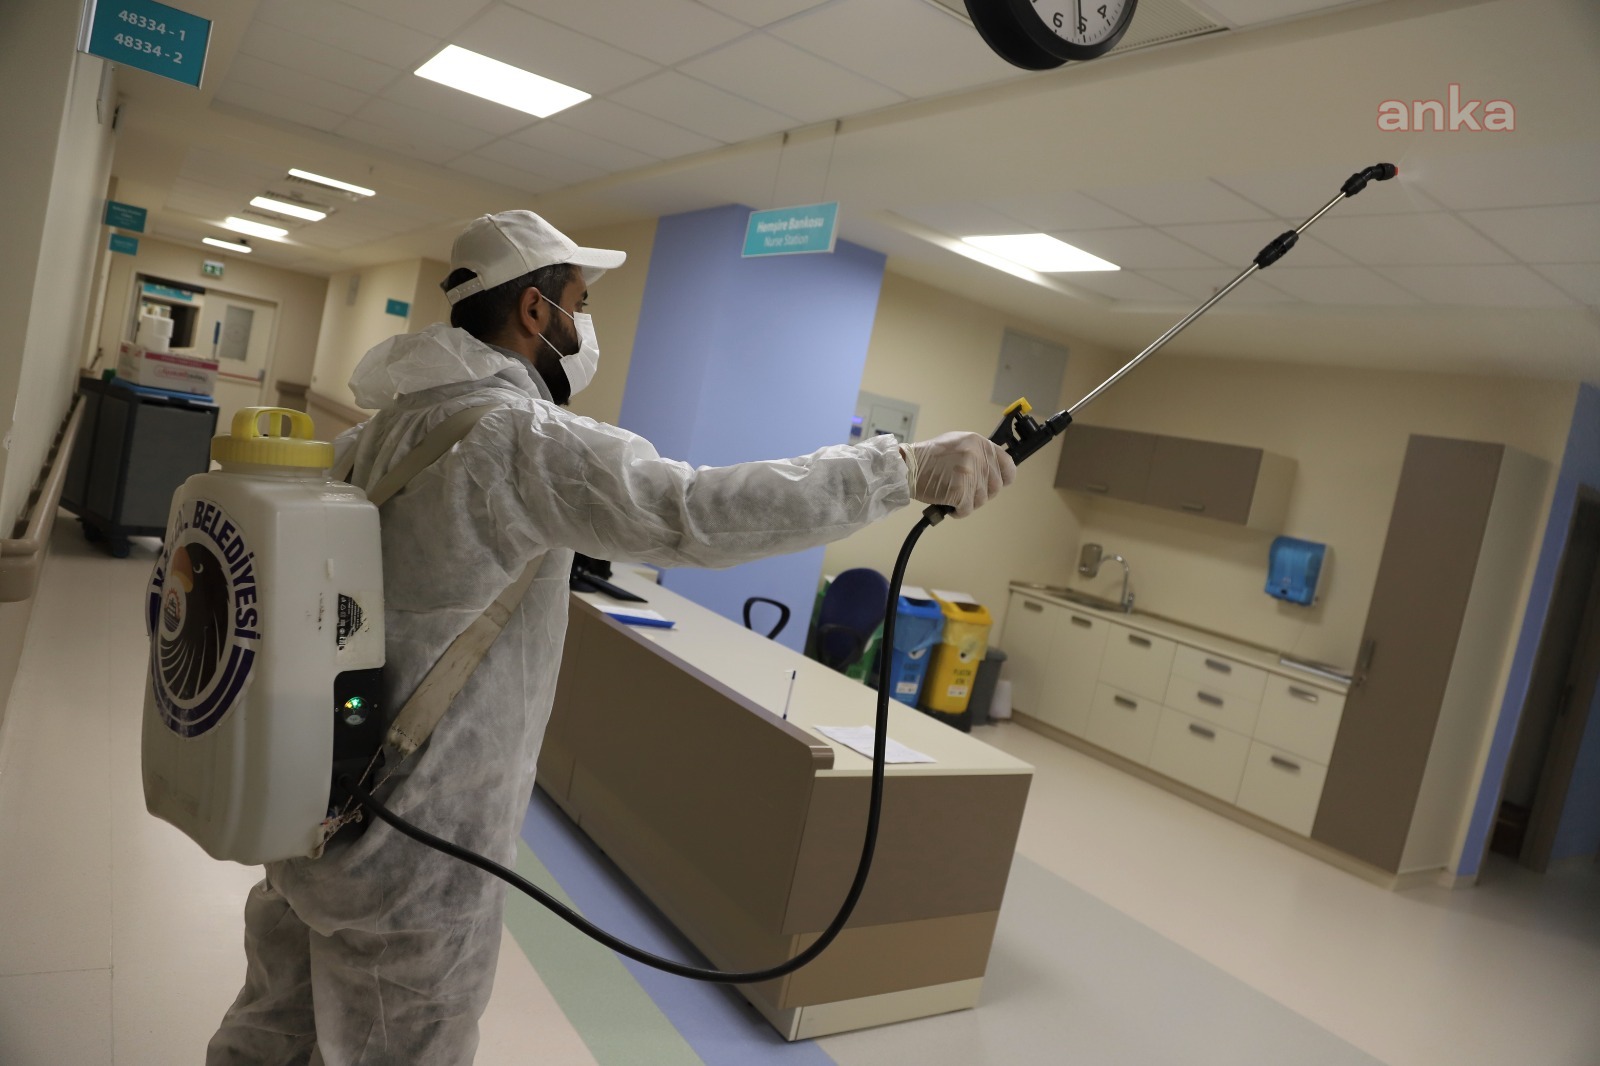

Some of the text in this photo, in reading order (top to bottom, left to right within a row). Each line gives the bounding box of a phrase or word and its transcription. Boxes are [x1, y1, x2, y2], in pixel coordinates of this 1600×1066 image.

[118, 10, 166, 34] 48334
[179, 30, 186, 41] 1
[1052, 12, 1064, 28] 6
[1097, 4, 1108, 19] 4
[114, 33, 162, 57] 48334
[172, 52, 183, 64] 2
[192, 500, 261, 640] BELEDİYESİ
